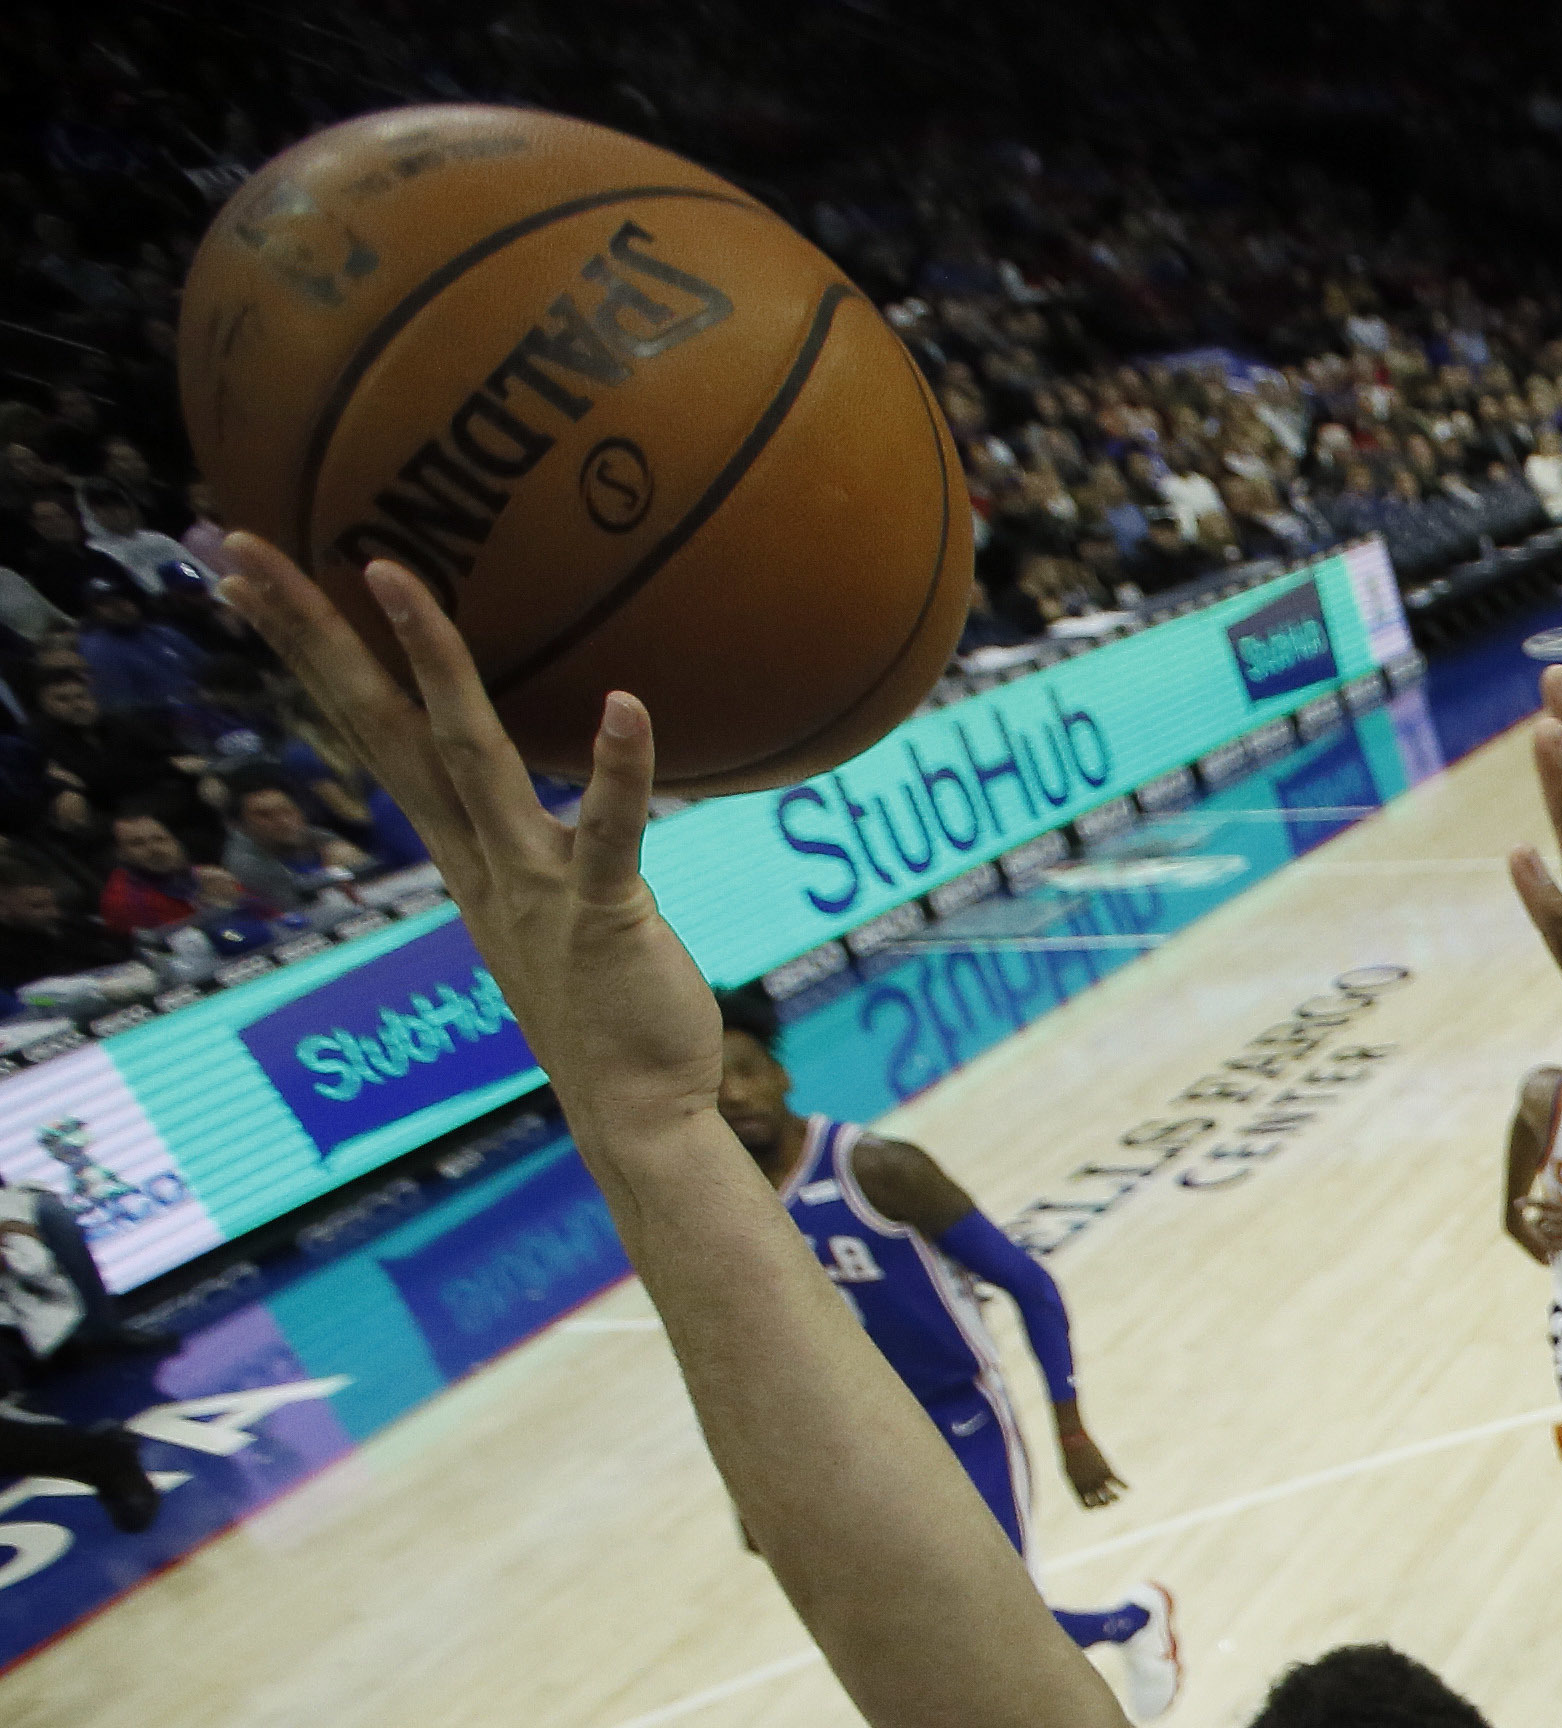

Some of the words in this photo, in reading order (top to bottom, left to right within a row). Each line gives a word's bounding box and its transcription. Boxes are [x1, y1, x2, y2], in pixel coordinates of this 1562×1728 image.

[775, 684, 1108, 914] StubHub
[295, 965, 520, 1102] StubHu
[995, 1115, 1218, 1258] ELLS
